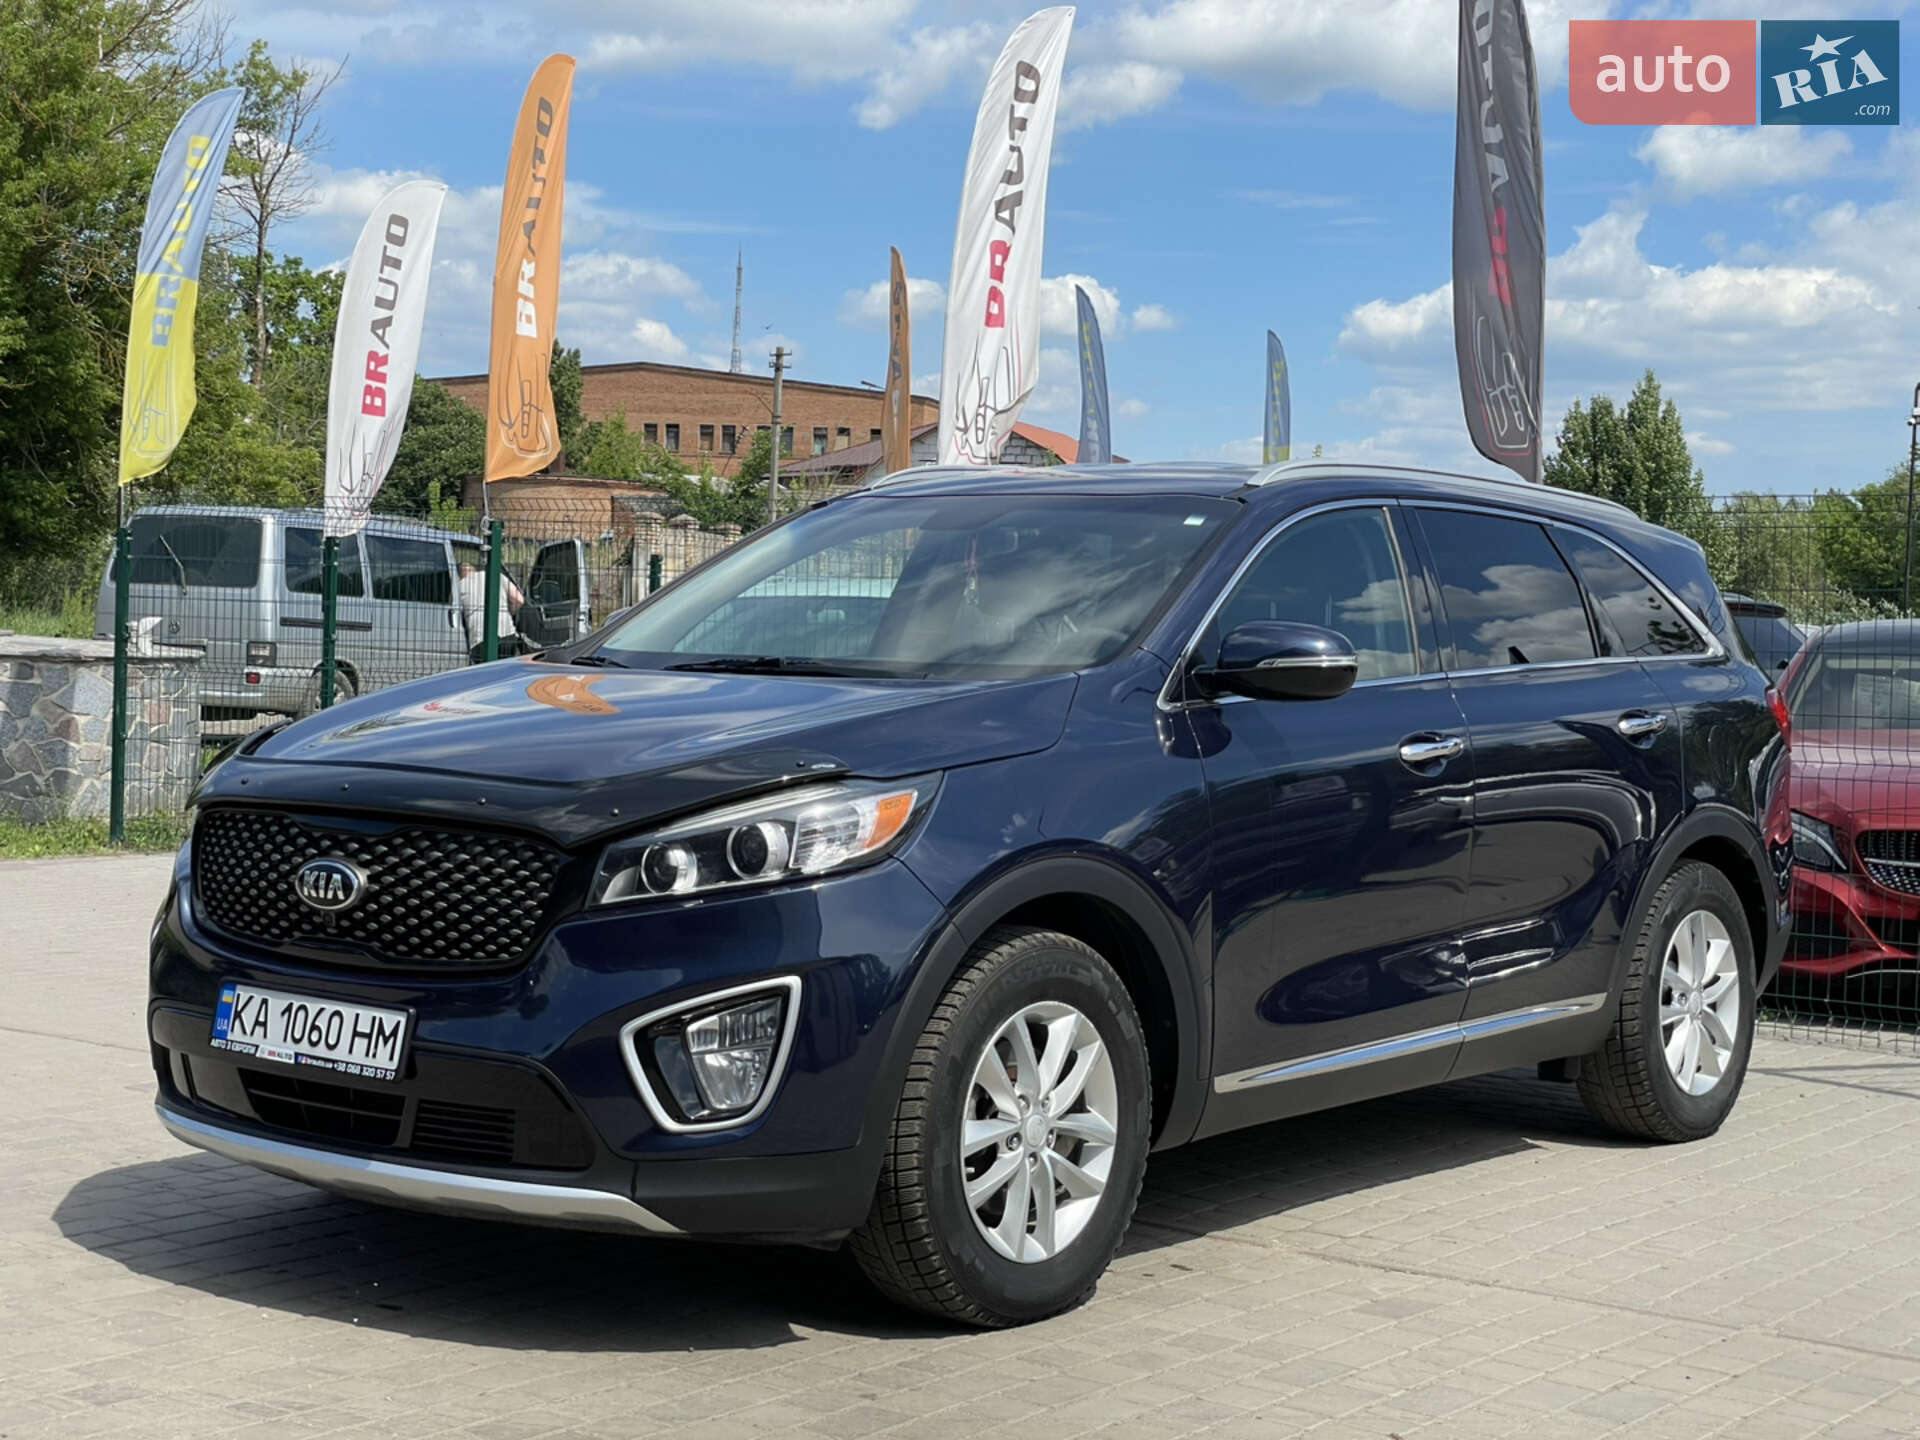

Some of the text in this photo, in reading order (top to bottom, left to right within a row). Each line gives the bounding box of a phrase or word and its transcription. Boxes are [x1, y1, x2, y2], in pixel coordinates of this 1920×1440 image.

[361, 213, 410, 418] BRAUTO
[302, 870, 345, 900] KIA
[230, 992, 401, 1062] KA 1060 HM
